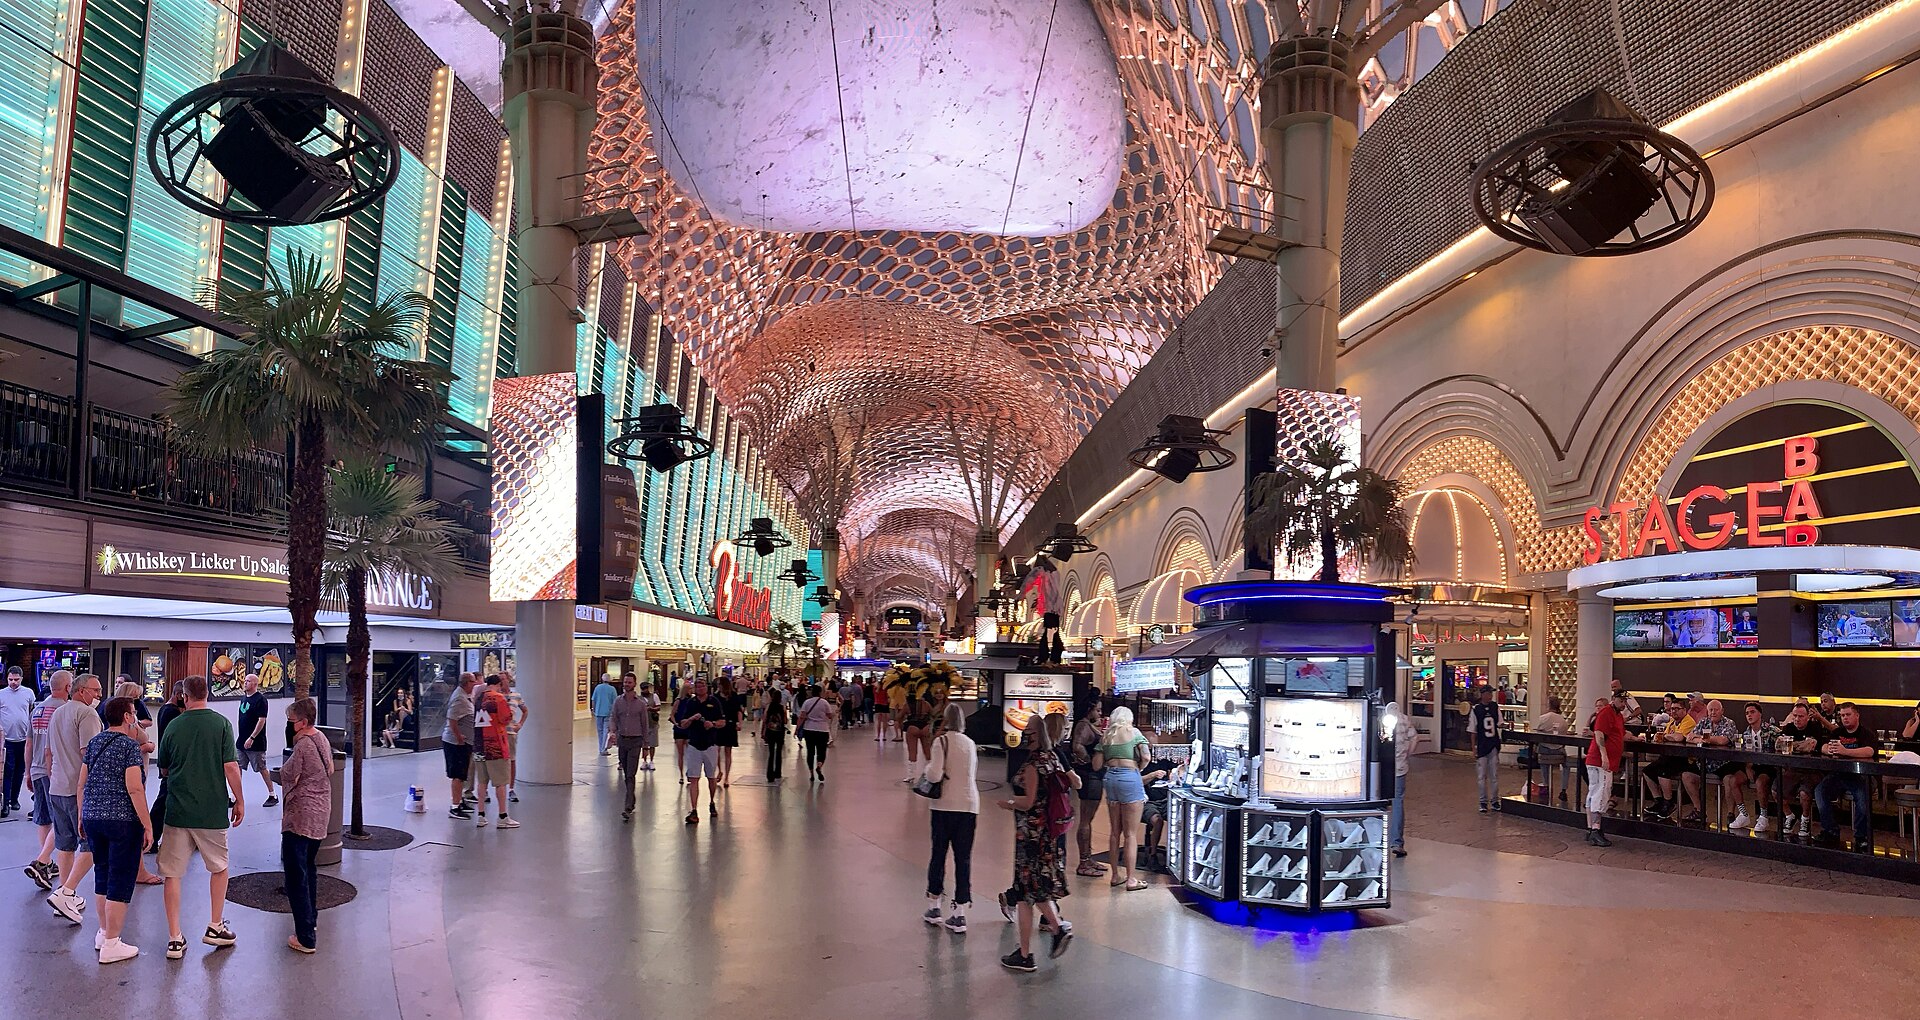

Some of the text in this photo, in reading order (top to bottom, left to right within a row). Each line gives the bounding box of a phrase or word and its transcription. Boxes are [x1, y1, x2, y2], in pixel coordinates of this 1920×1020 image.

[1584, 482, 1785, 565] STAGE
[117, 551, 291, 576] Whiskey Licker Up Salo
[1483, 717, 1495, 738] 9
